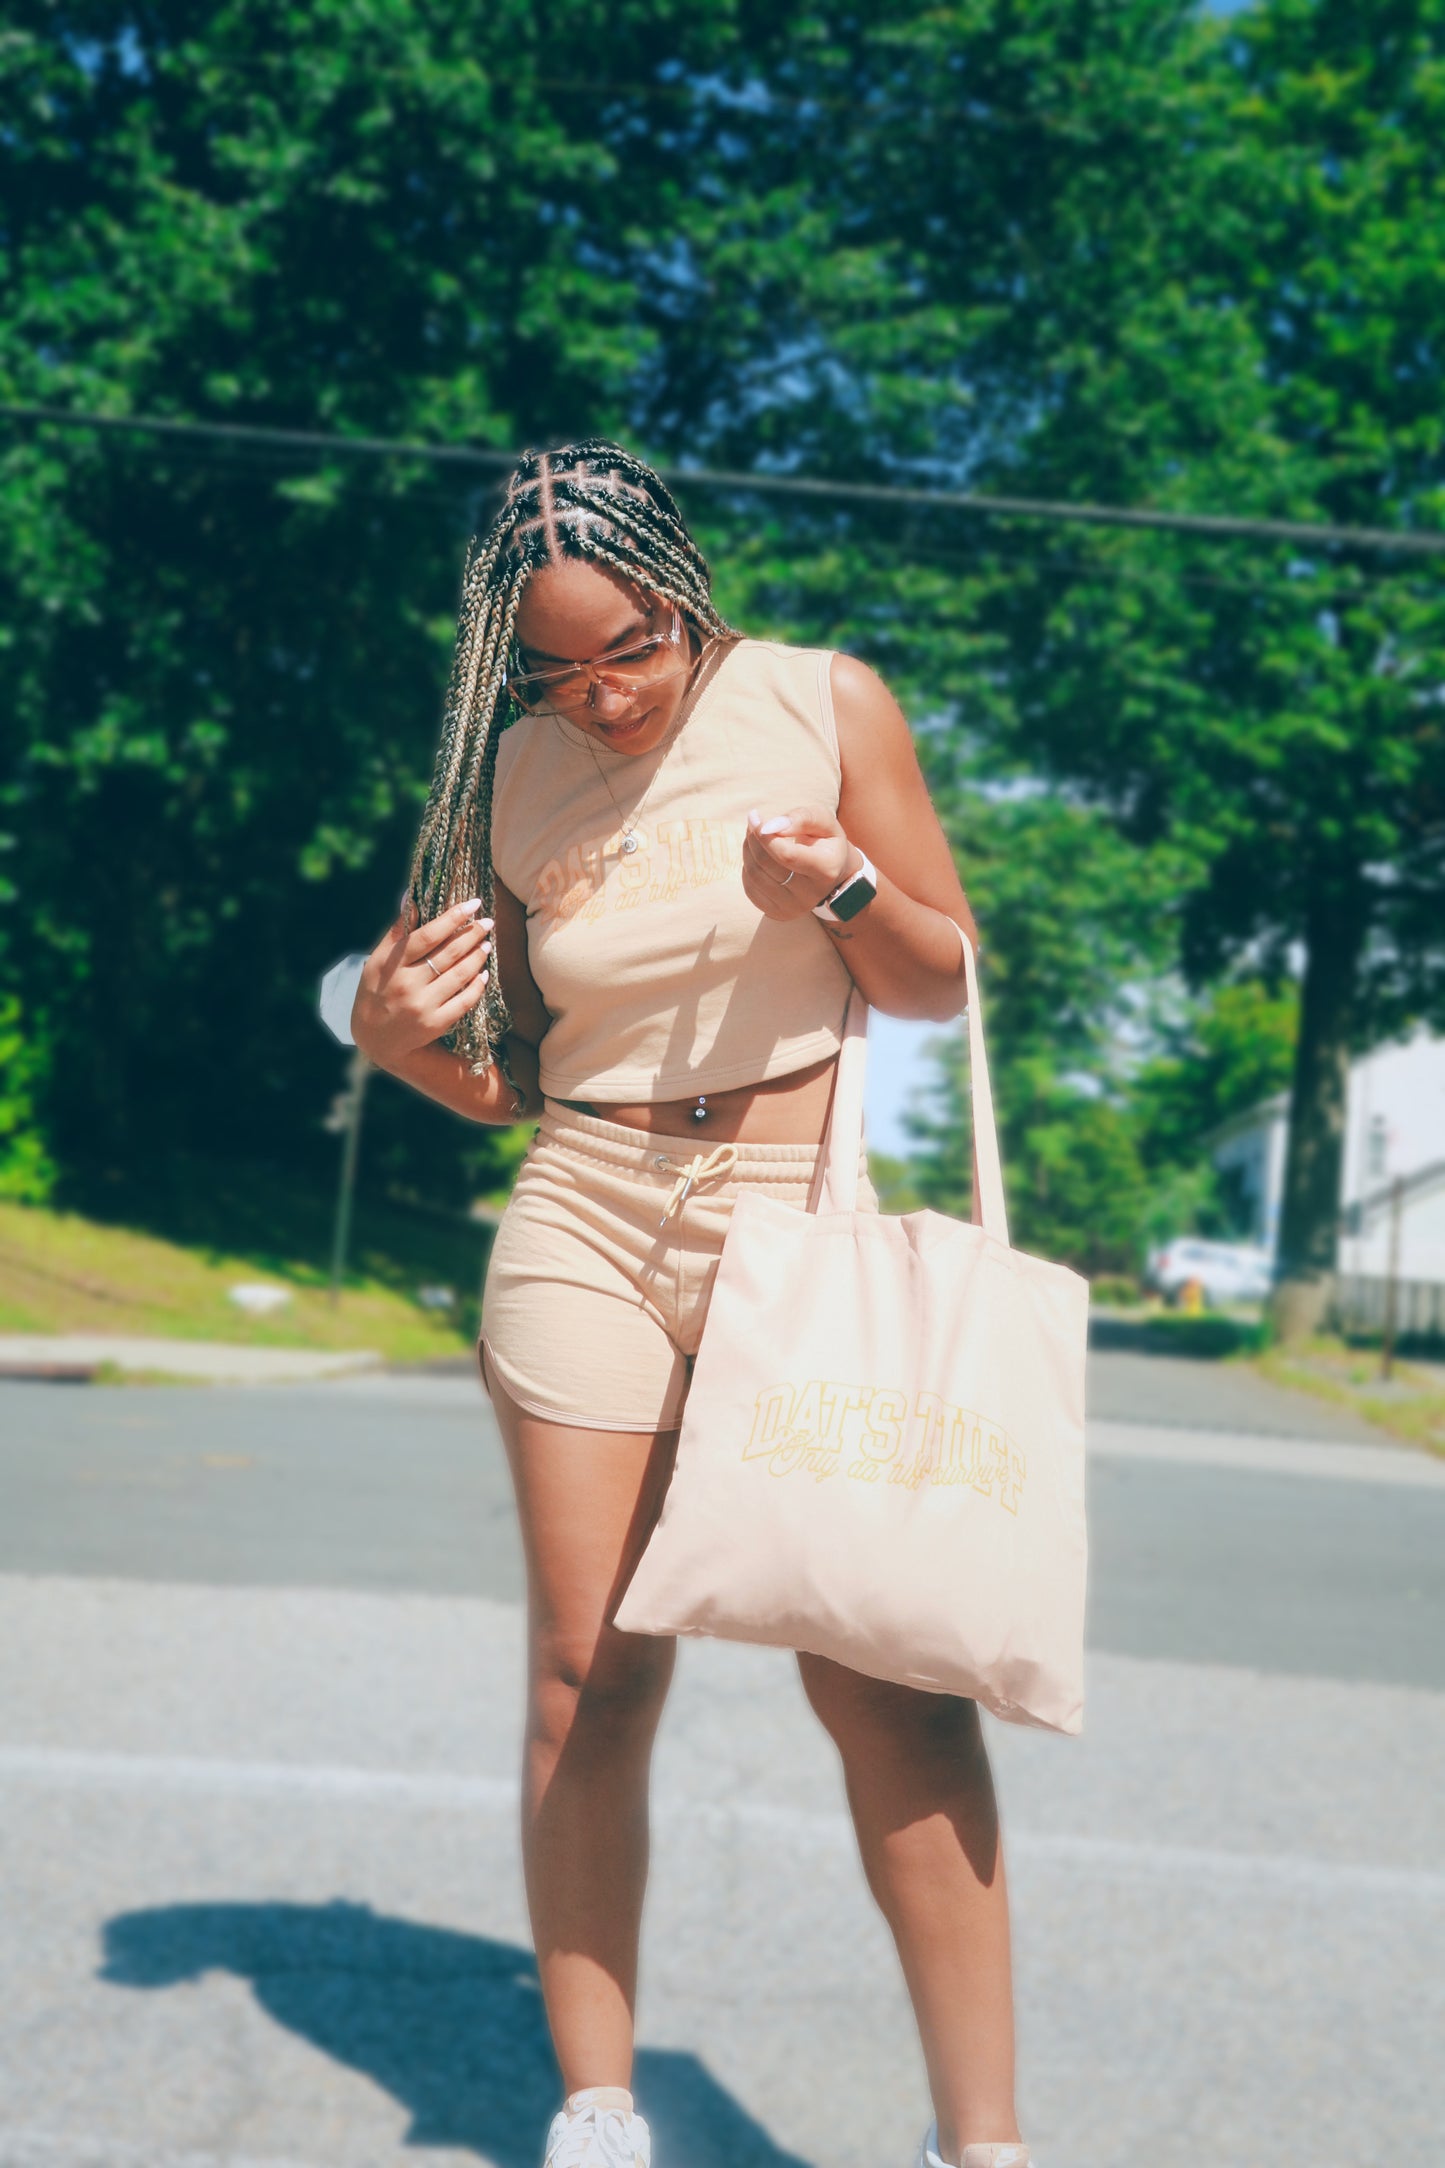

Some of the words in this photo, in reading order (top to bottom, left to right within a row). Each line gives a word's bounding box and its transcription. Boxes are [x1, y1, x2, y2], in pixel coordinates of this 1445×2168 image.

[742, 1379, 908, 1464] DAT'S
[914, 1391, 1027, 1517] TUFF
[768, 1423, 840, 1484] Only
[847, 1458, 881, 1483] da
[886, 1452, 931, 1491] tuff
